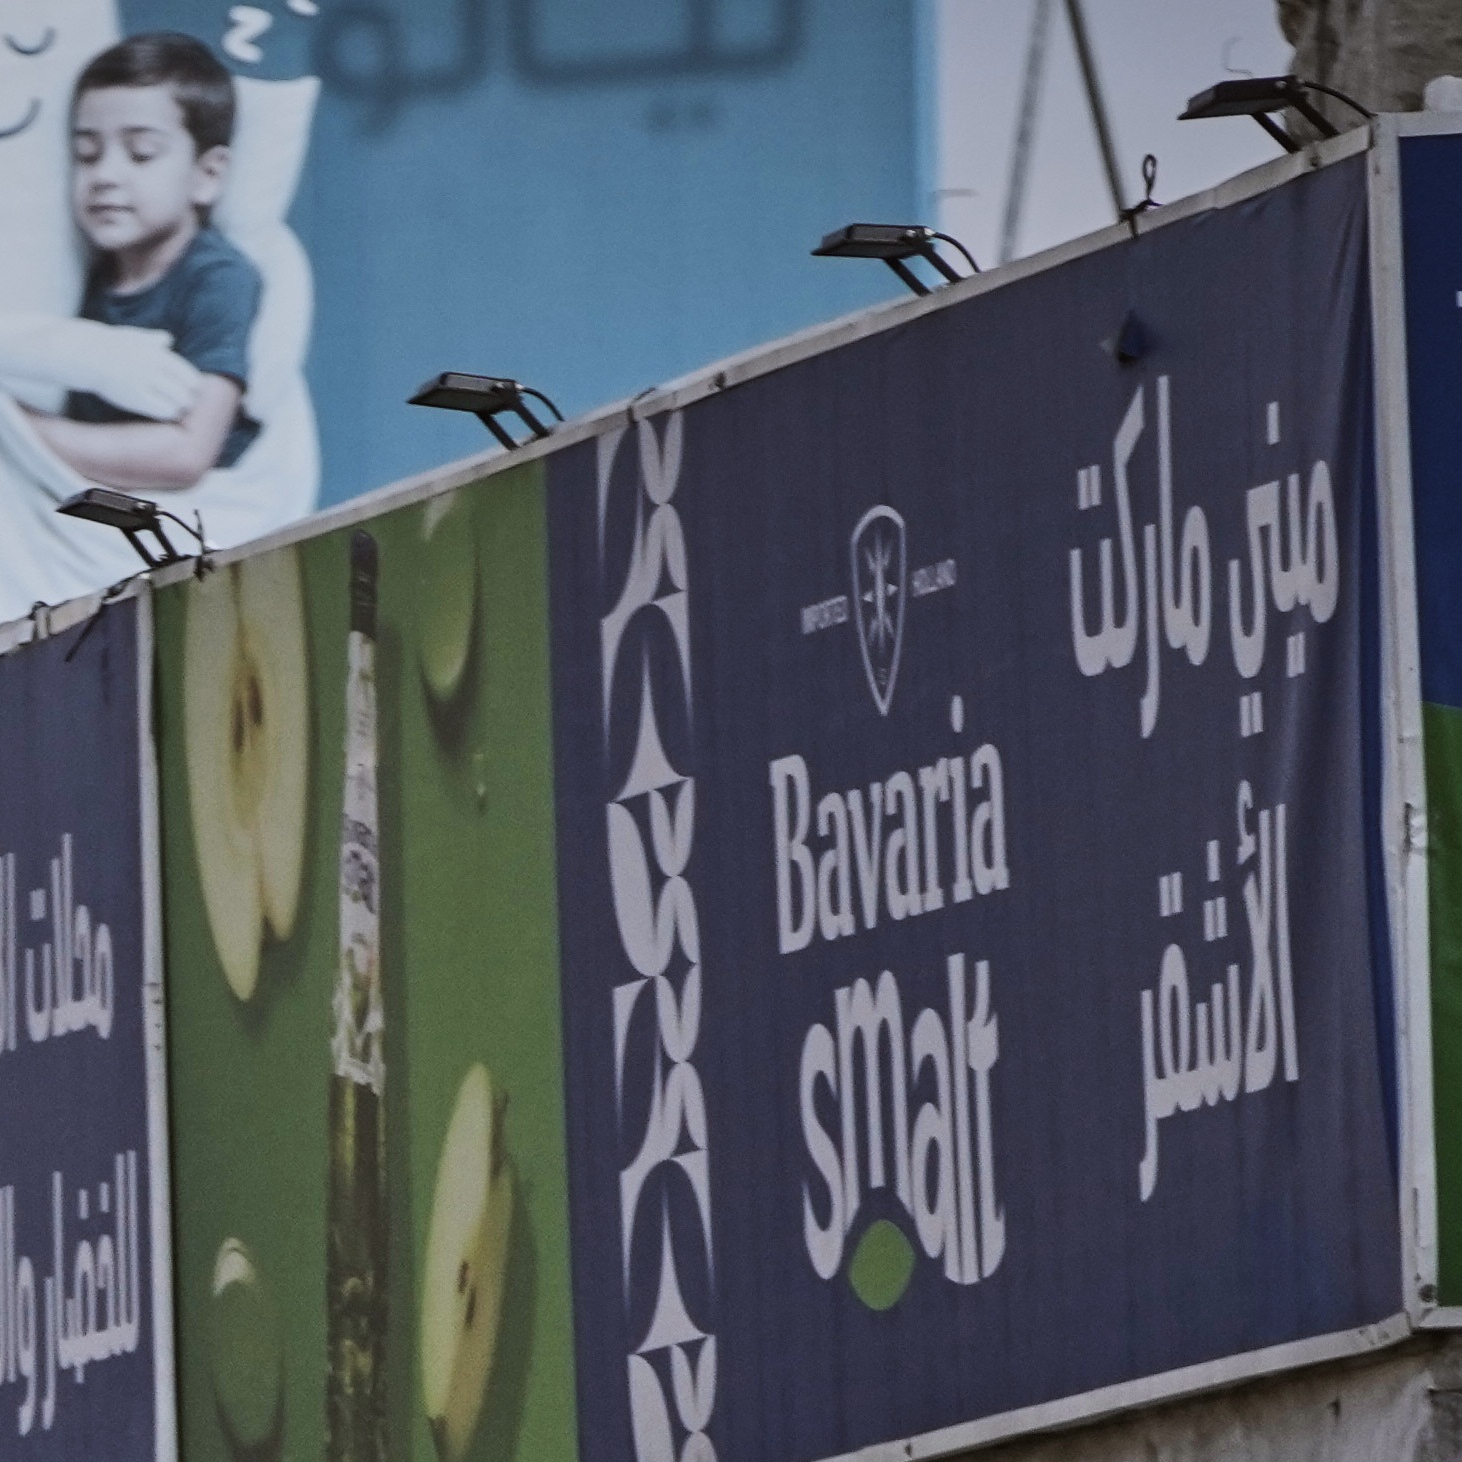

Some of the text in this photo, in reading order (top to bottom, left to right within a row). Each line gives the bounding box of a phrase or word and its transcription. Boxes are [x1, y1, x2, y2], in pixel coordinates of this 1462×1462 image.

[1069, 374, 1339, 740] ميني ماركت
[26, 832, 113, 1042] محلات
[769, 693, 1011, 954] Bavaria
[1137, 775, 1300, 1204] الأشقر
